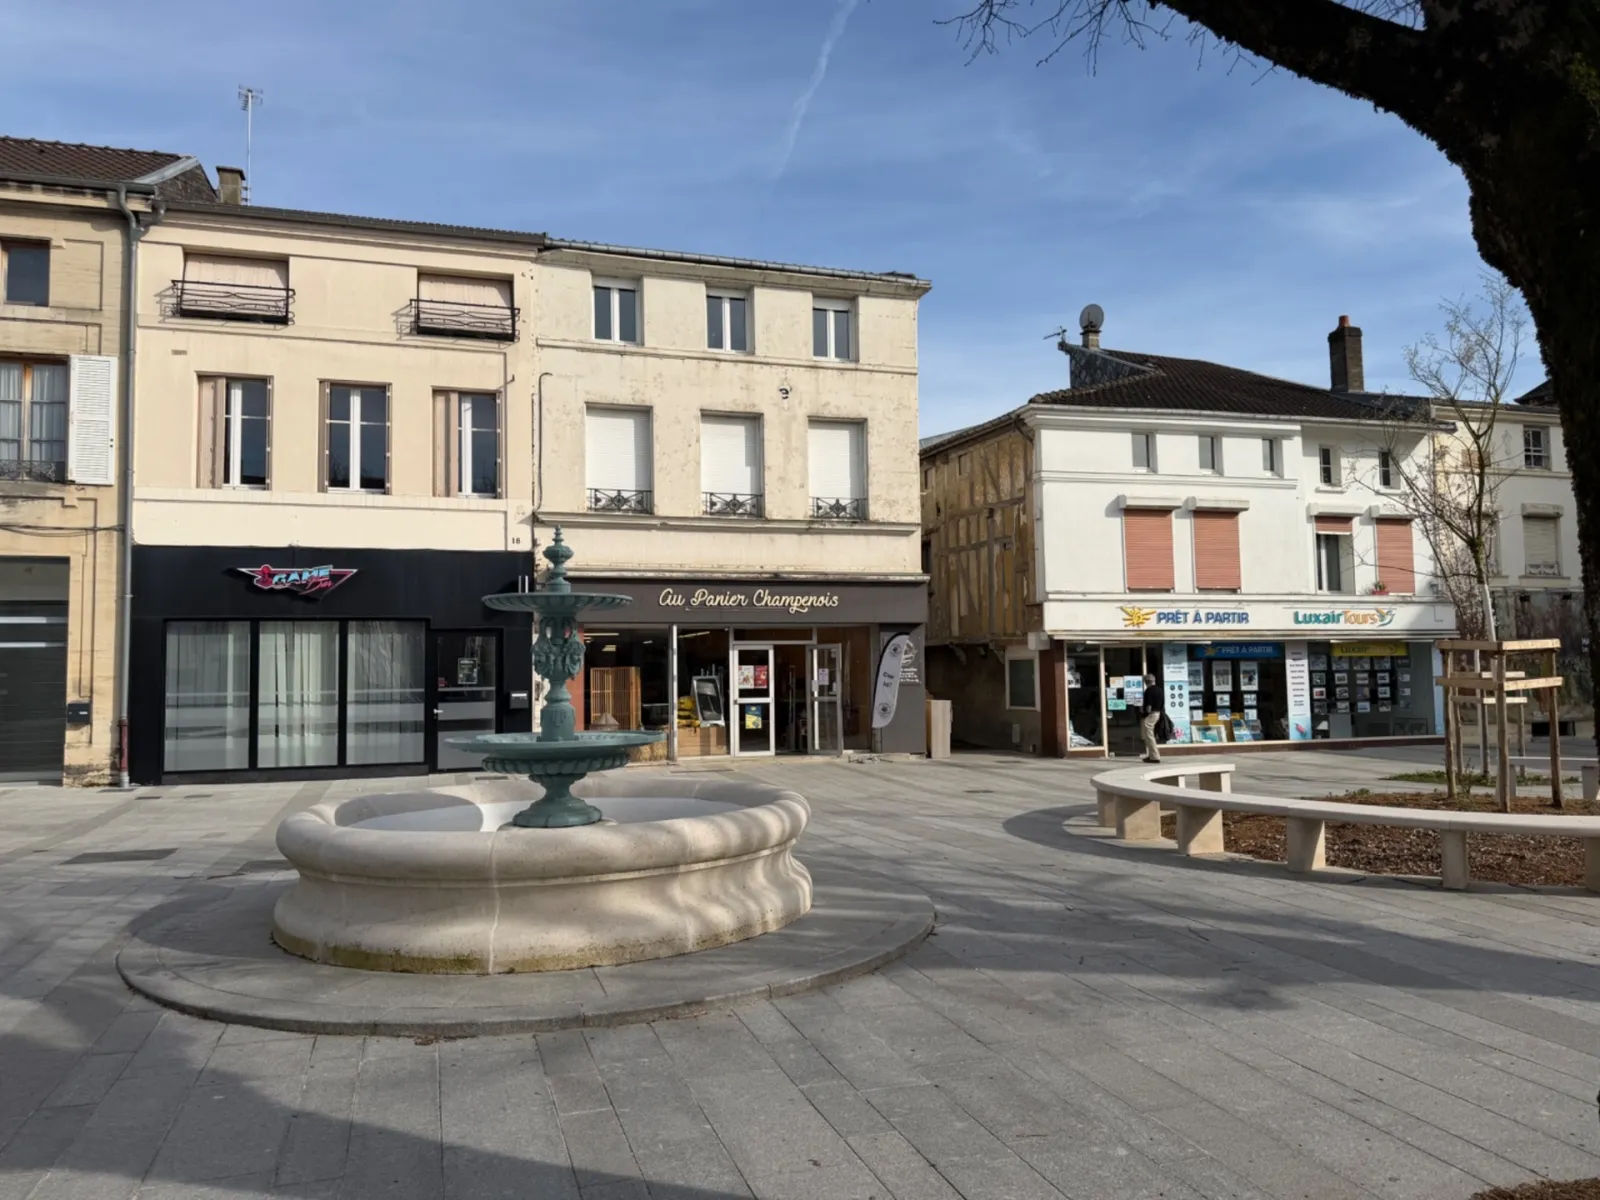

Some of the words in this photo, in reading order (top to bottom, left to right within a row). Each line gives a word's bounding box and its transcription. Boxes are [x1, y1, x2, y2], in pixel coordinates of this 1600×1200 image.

[272, 566, 333, 588] GAME
[659, 588, 684, 606] Au
[690, 588, 748, 606] Panier
[753, 589, 839, 614] Champenois
[1156, 609, 1189, 624] PRÊT
[1192, 609, 1203, 624] À
[1205, 611, 1250, 624] PARTIR
[1293, 609, 1378, 625] LuxairTours
